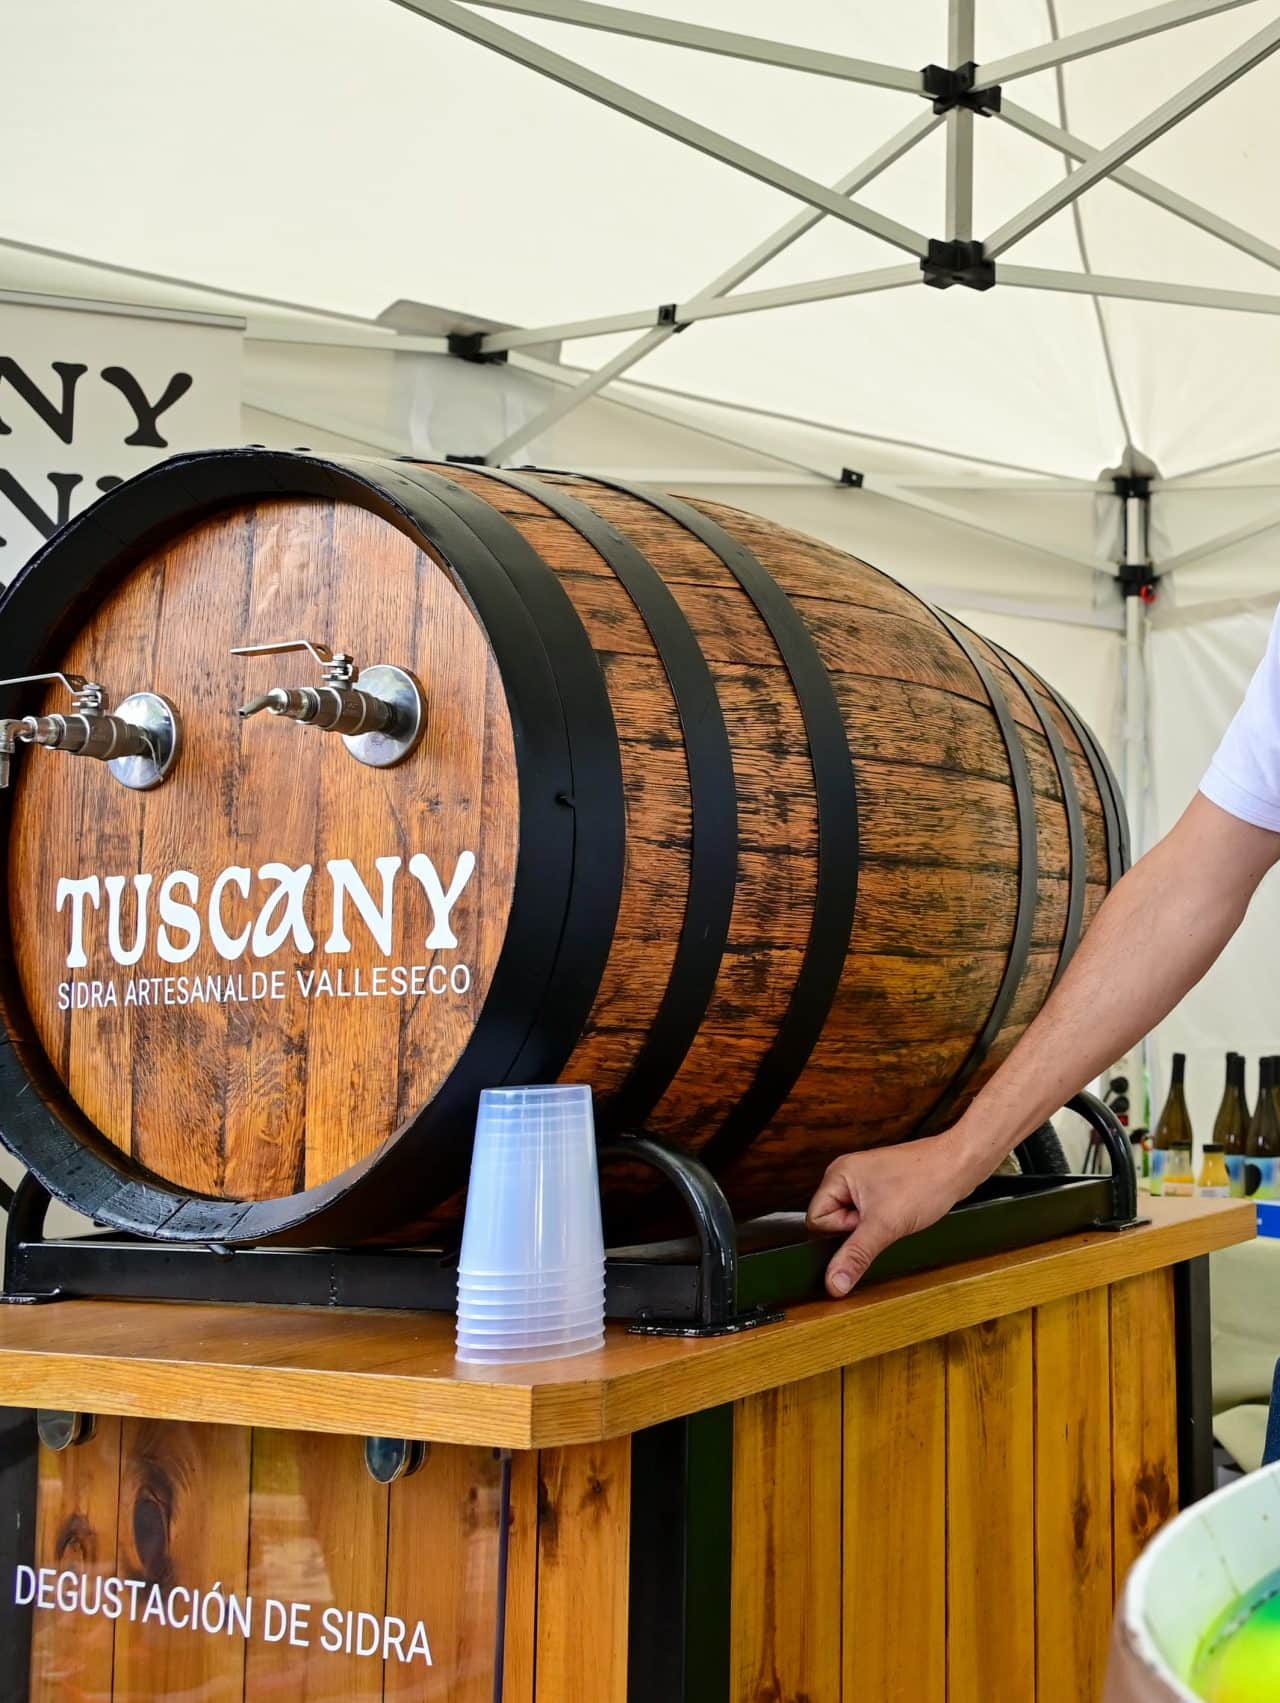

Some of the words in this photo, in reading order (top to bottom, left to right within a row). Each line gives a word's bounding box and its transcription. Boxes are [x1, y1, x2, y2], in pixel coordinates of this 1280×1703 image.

[58, 981, 117, 1010] SIDRA
[124, 973, 249, 1006] ARTESANAL
[252, 971, 285, 1000] DE
[296, 964, 471, 998] VALLESECO
[14, 1564, 252, 1637] DEGUSTACIÓN
[264, 1600, 310, 1647] DE
[320, 1608, 433, 1666] SIDRA
